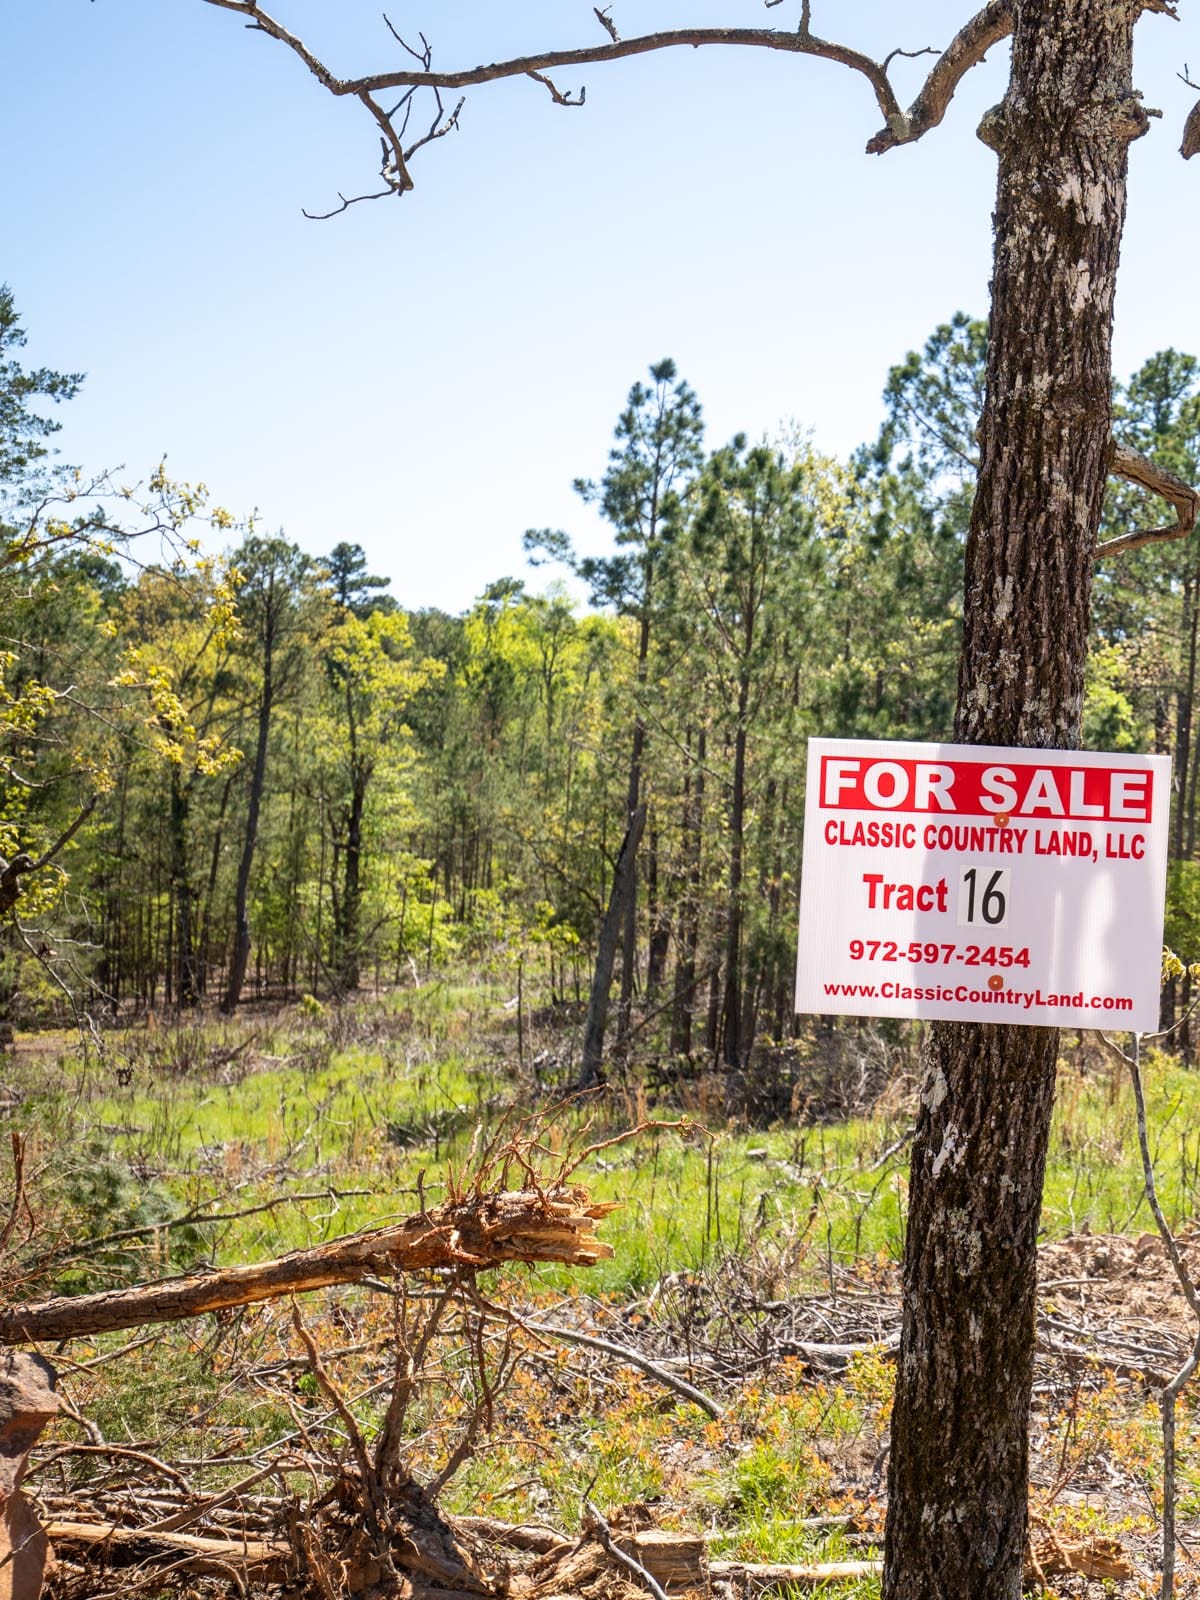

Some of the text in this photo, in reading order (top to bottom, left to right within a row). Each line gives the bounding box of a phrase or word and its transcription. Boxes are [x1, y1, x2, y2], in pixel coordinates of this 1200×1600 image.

[825, 760, 1147, 819] FOR SALE
[824, 819, 1145, 863] CLASSIC COUNTRY LAND, LLC
[863, 868, 1007, 925] Tract 16
[849, 940, 1031, 968] 972-597-2454
[823, 981, 1134, 1011] www.ClassicCountryLand.com
